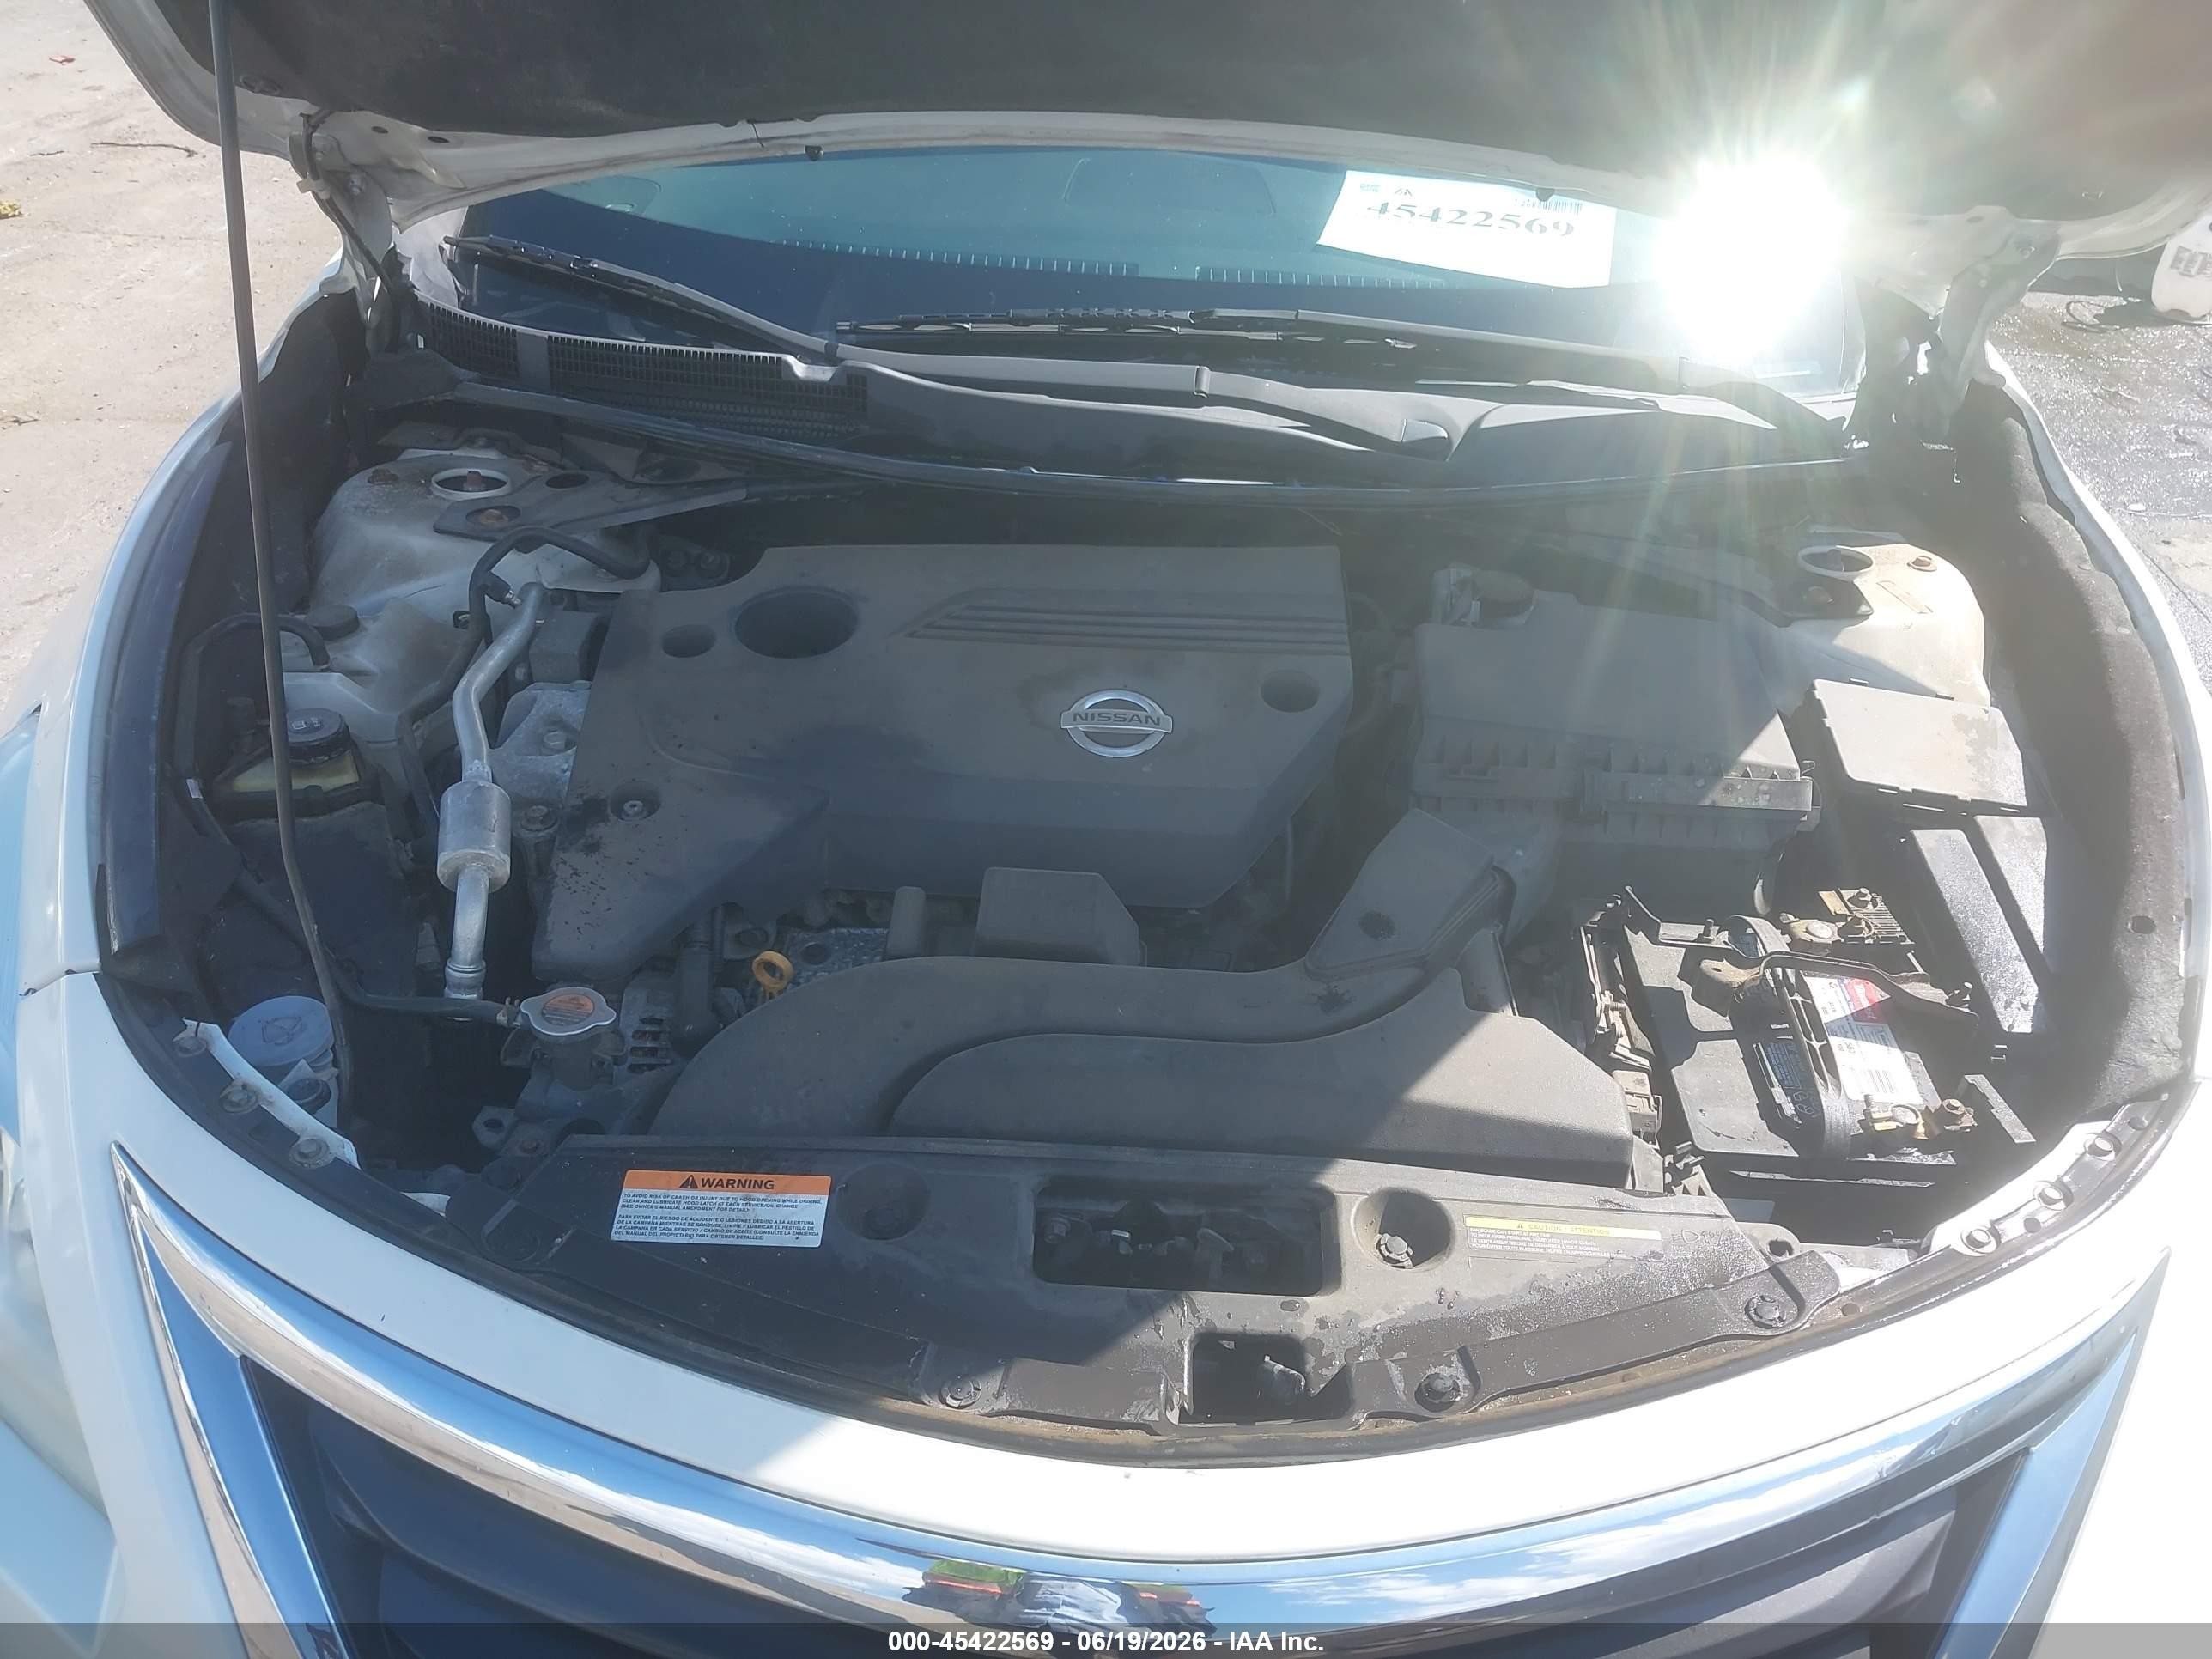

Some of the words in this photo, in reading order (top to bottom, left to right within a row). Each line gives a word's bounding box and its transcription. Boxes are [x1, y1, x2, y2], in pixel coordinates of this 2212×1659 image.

[1367, 202, 1576, 237] 45422569
[1073, 712, 1160, 726] NISSAN
[701, 1177, 775, 1190] WARNING
